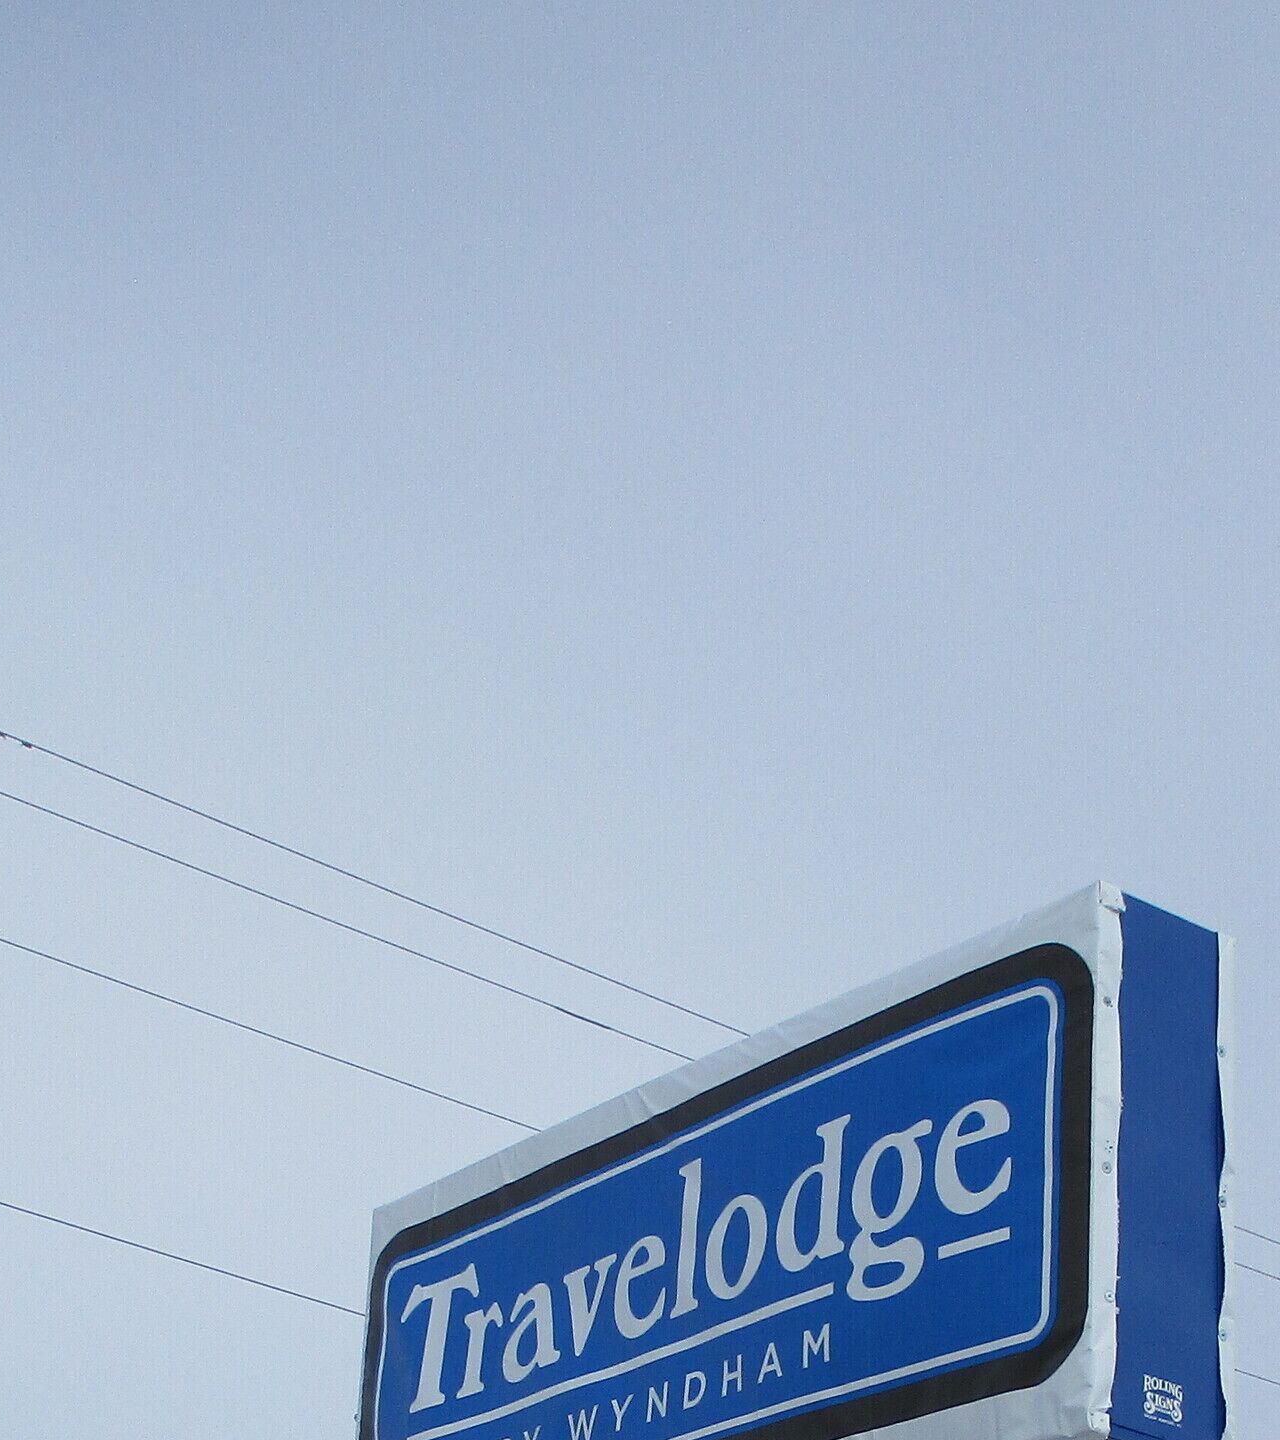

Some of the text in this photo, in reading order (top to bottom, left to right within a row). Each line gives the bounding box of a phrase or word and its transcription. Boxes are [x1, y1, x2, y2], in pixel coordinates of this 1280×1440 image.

[401, 1099, 1012, 1413] Travelodge
[1143, 1373, 1183, 1402] ROLING
[1143, 1391, 1183, 1423] SIGNS
